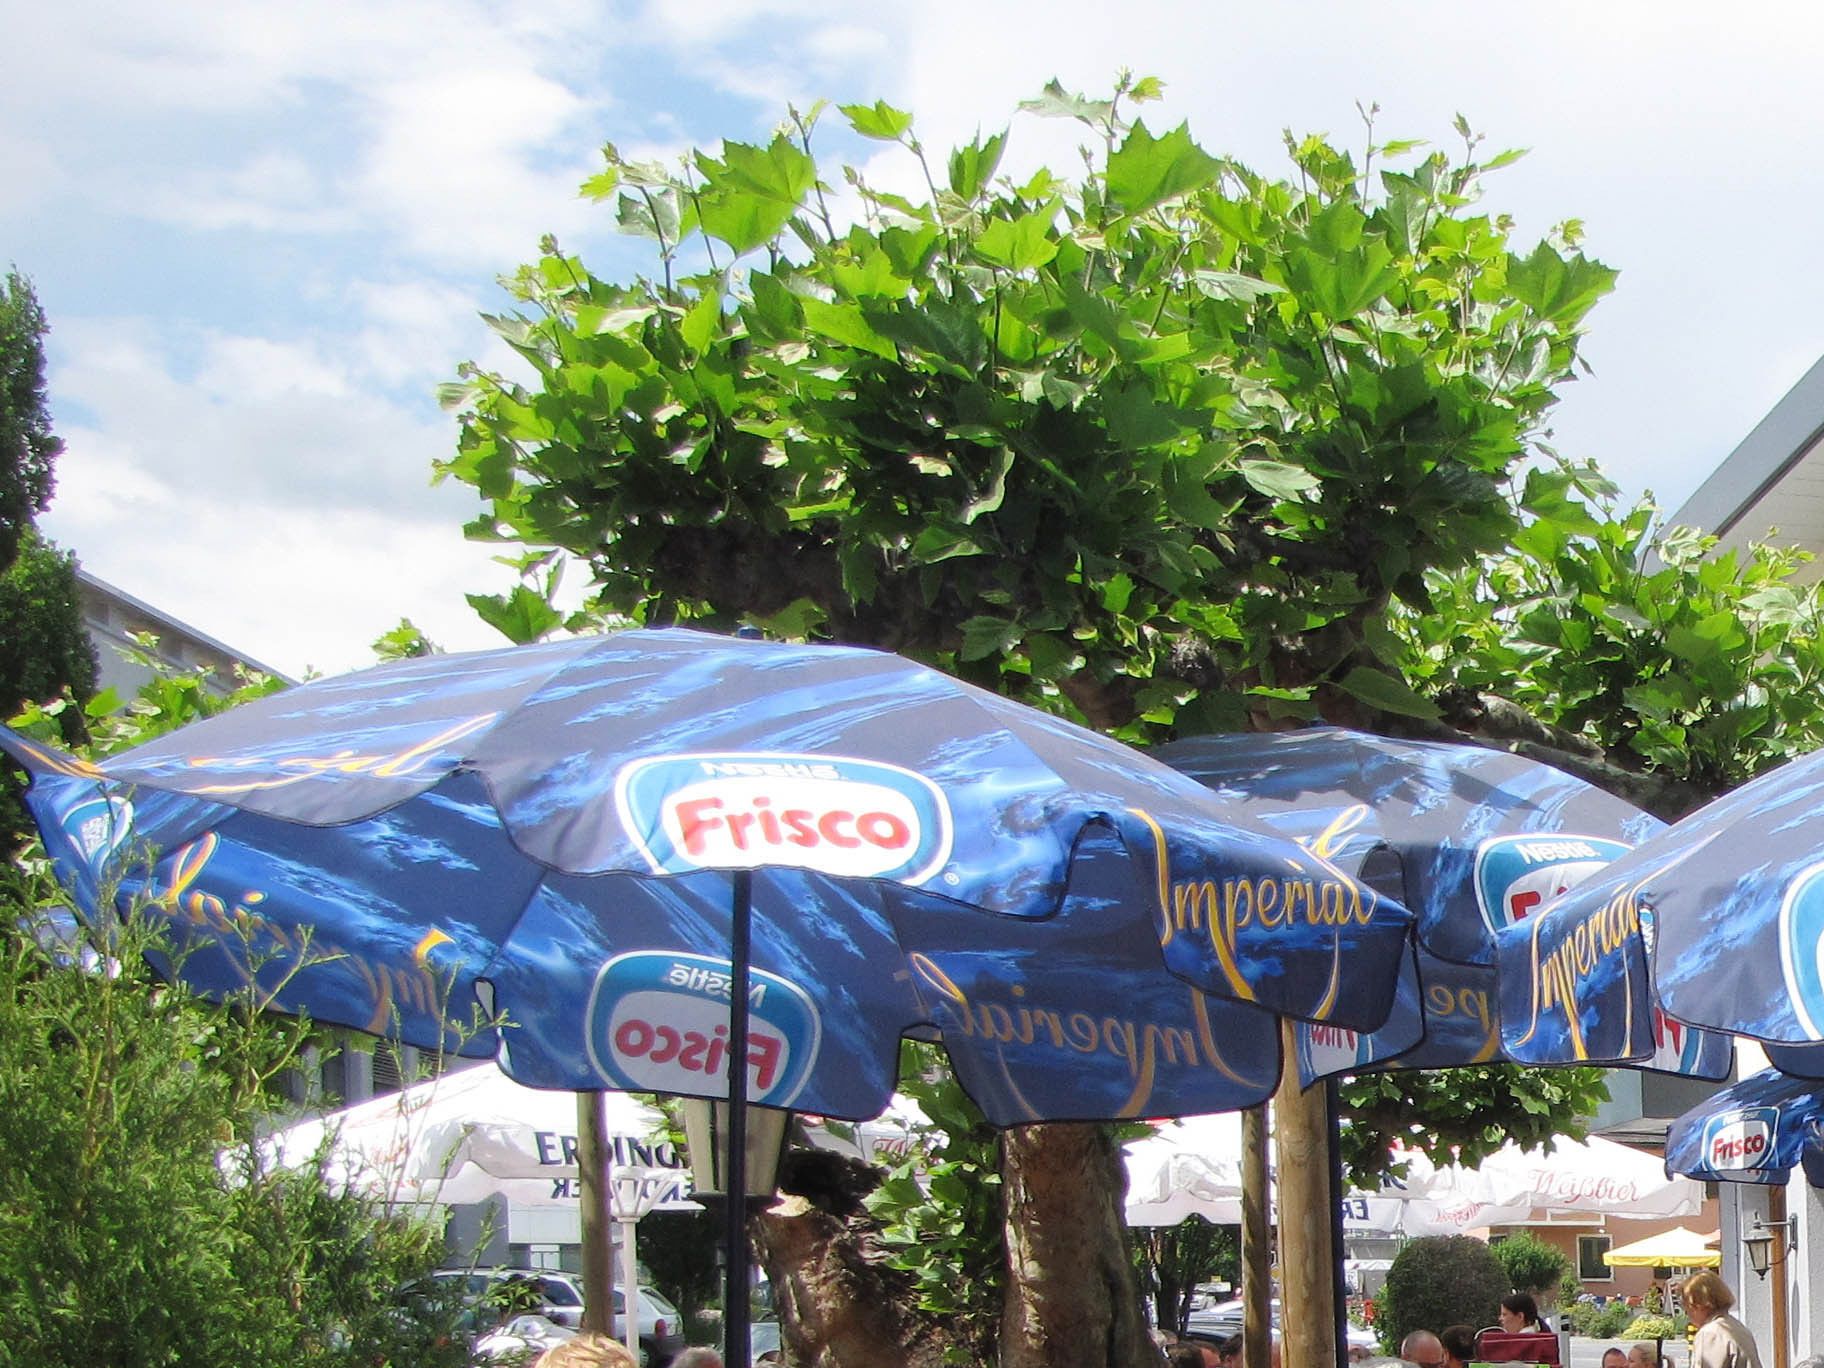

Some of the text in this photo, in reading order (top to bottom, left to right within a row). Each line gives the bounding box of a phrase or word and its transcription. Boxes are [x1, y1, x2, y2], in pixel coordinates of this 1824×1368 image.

[675, 796, 911, 857] Frisco
[1127, 806, 1377, 1021] Imperial
[534, 1131, 681, 1169] ERING
[1712, 1133, 1766, 1163] Frisco
